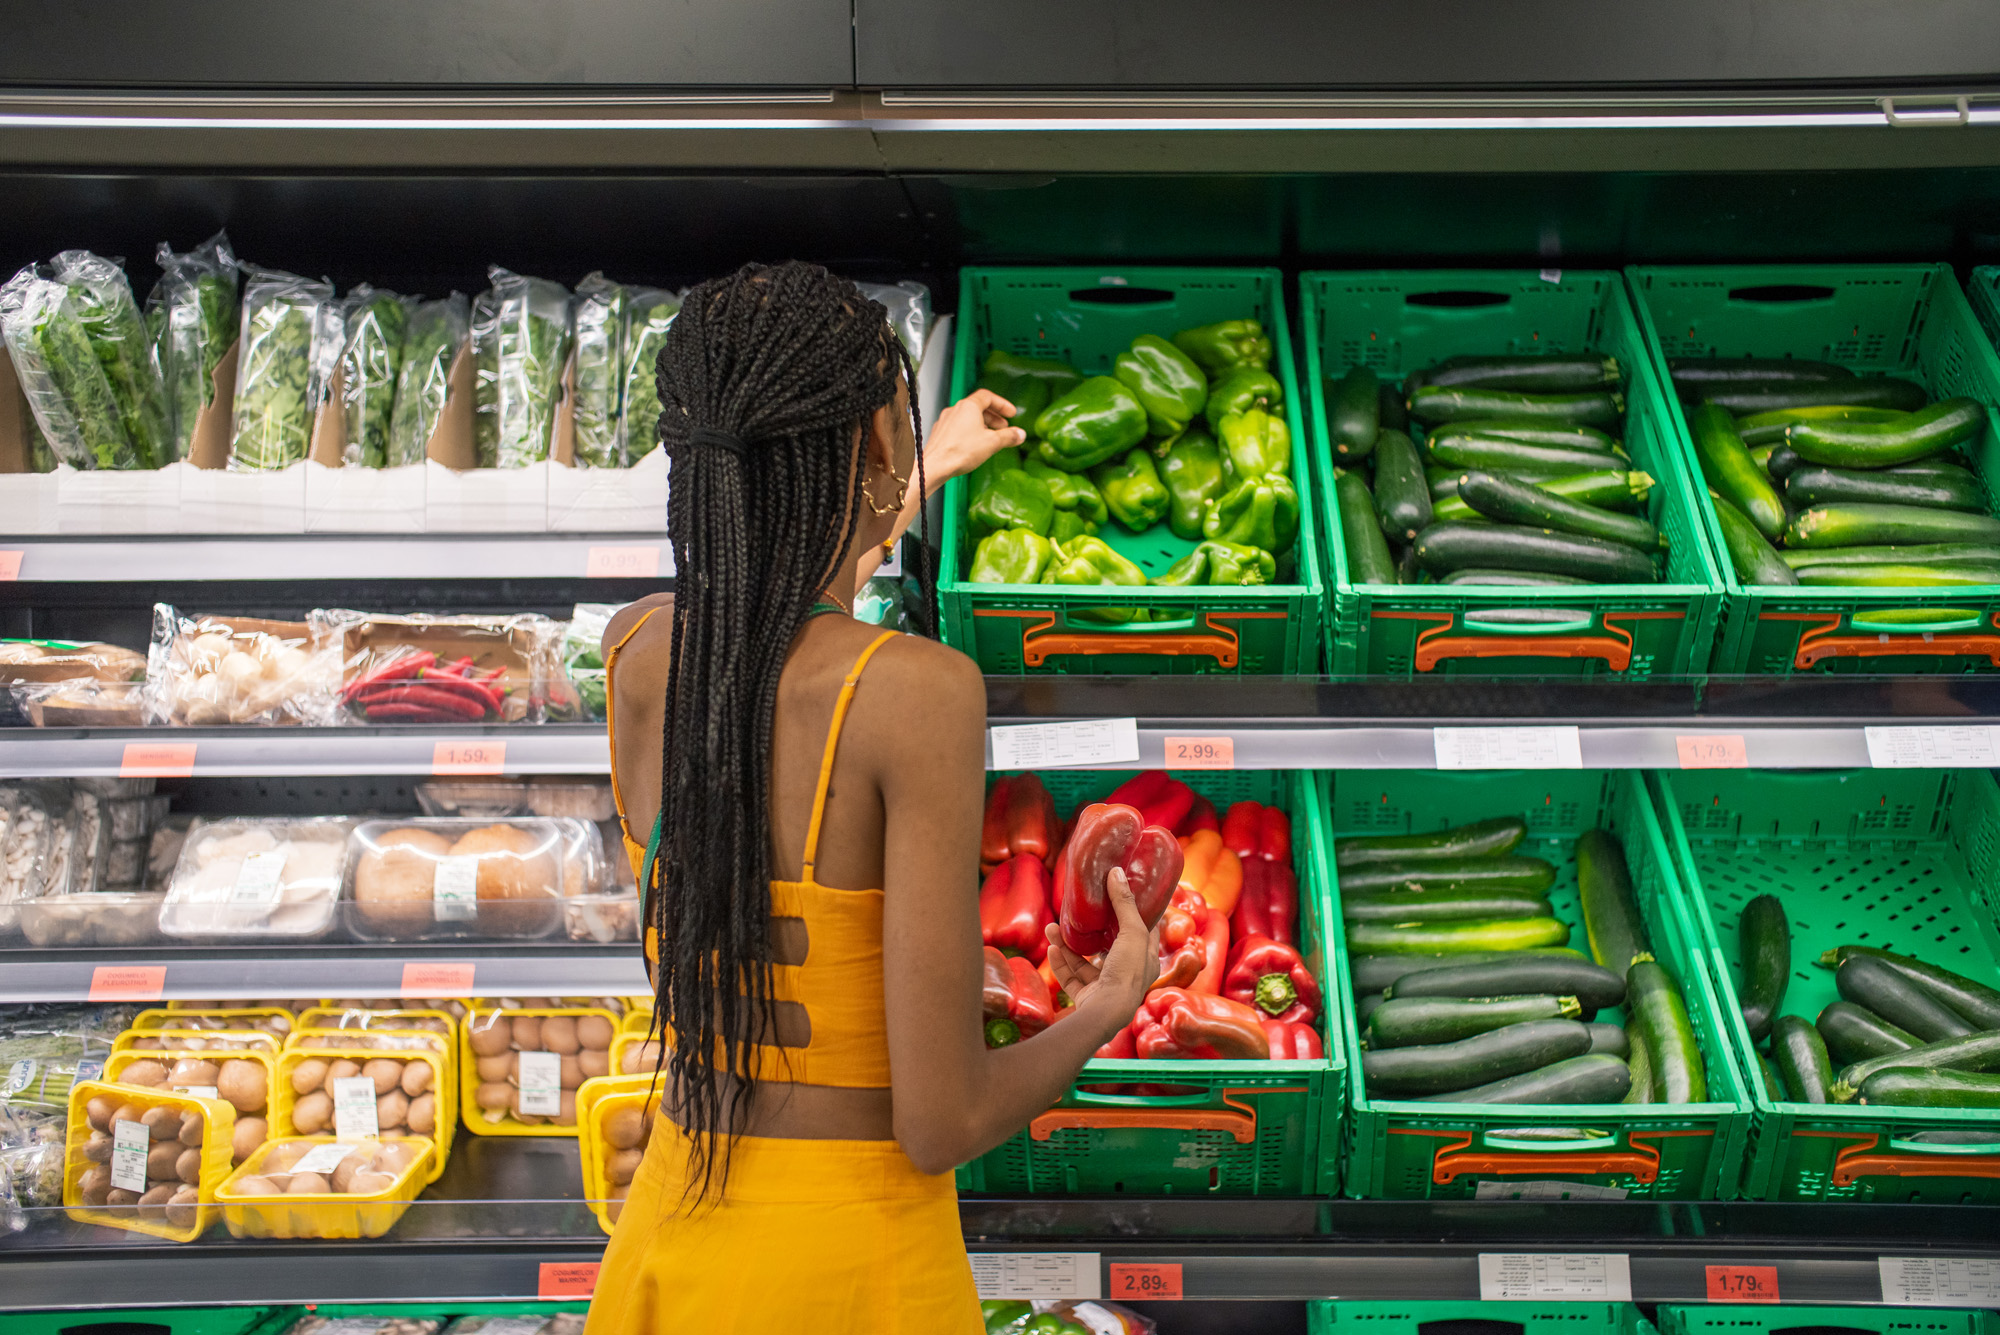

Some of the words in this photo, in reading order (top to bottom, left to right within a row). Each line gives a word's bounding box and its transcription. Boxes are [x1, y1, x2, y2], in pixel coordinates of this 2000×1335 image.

[448, 748, 488, 763] 1,59€
[1178, 744, 1220, 760] 2,99€
[1690, 743, 1733, 759] 1,79€
[1125, 1275, 1168, 1292] 2,89€
[1719, 1275, 1764, 1293] 1,79€
